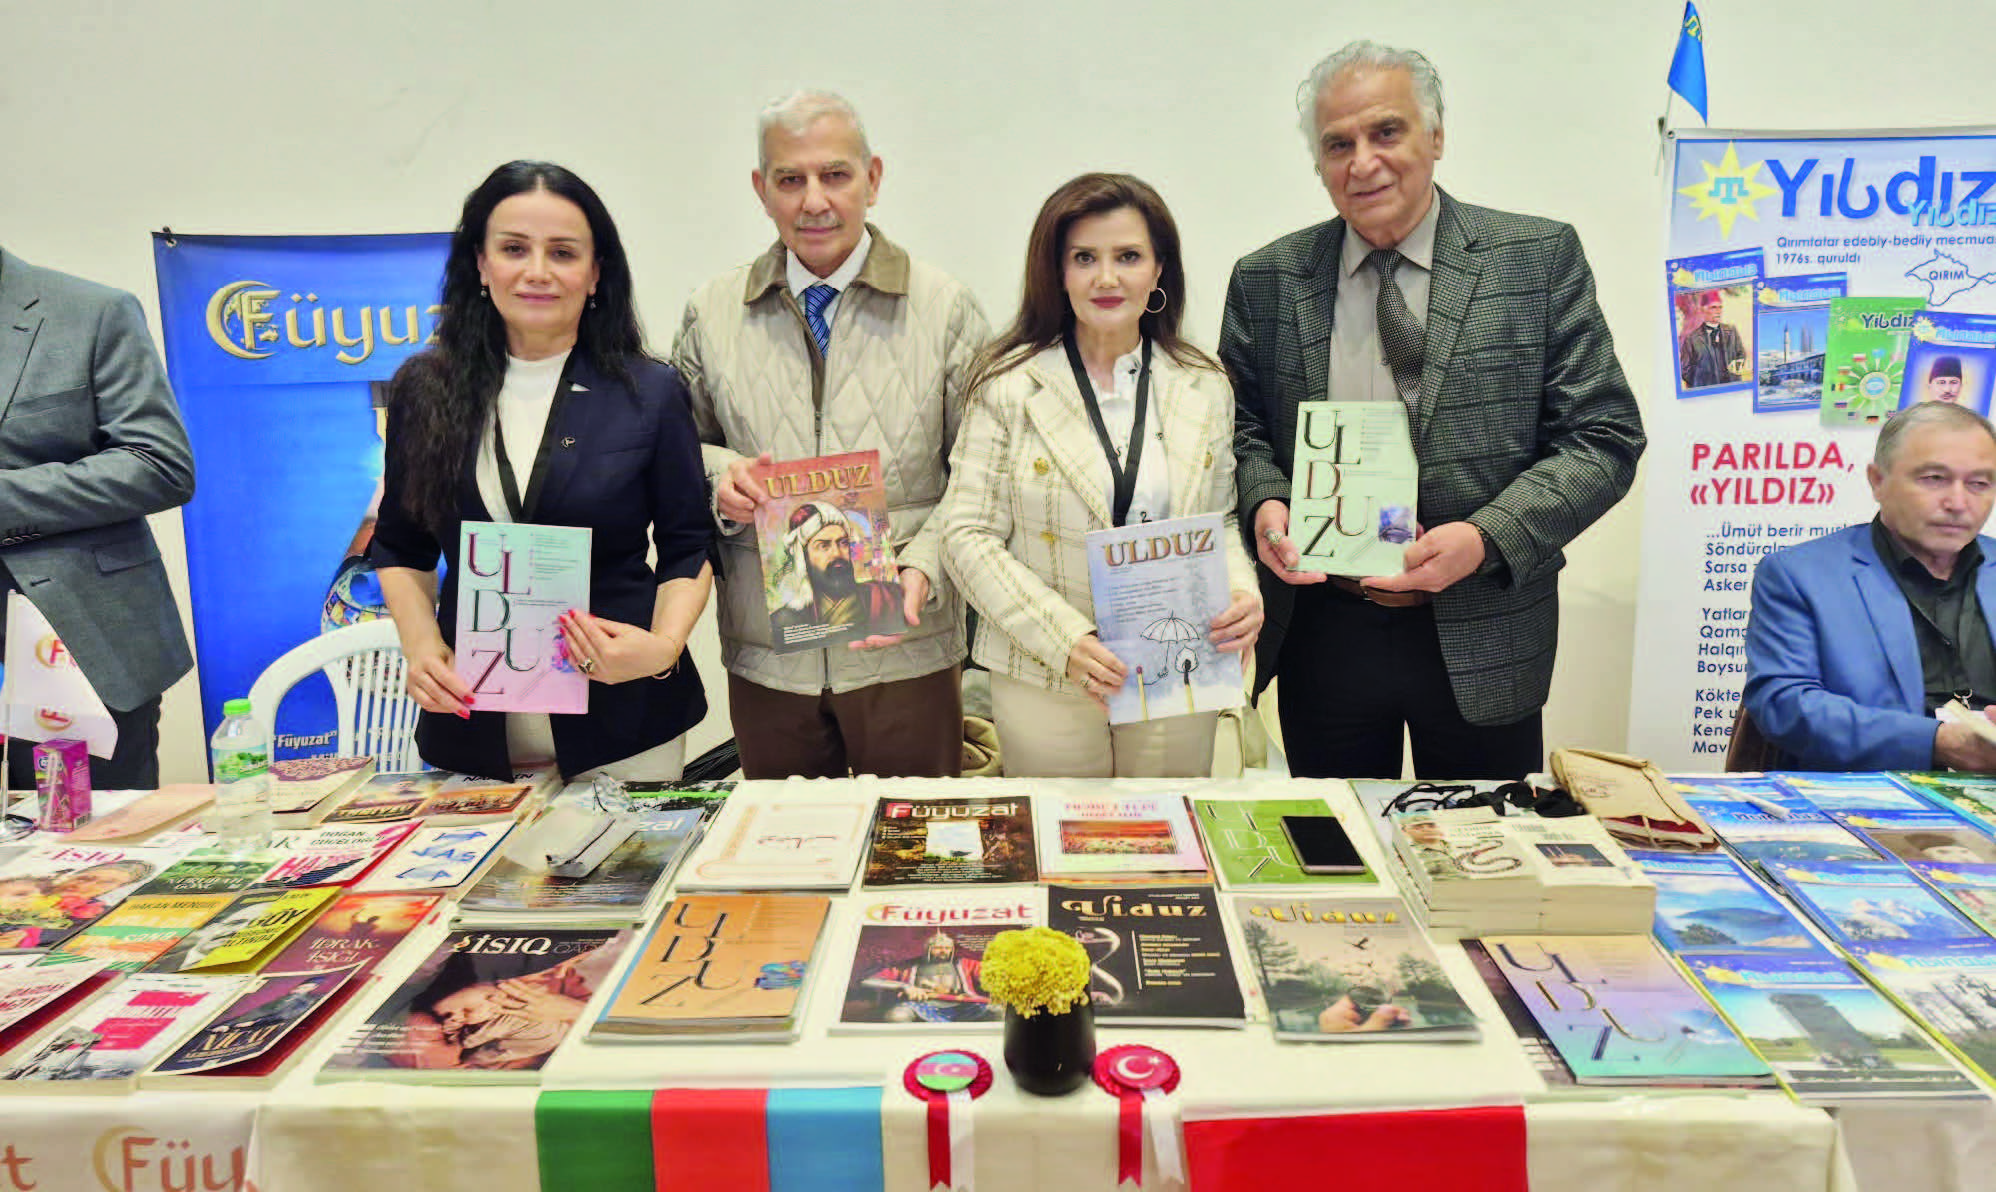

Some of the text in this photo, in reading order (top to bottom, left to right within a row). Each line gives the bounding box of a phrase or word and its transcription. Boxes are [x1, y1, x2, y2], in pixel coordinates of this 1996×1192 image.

[1936, 235, 1996, 245] mecmua
[1929, 270, 1965, 281] QIRIM
[1691, 441, 1854, 472] PARILDA,
[765, 465, 873, 499] ULDUZ
[1767, 523, 1804, 537] berir
[1103, 528, 1216, 567] ULDUZ
[1704, 560, 1747, 574] Sarsa
[1704, 578, 1748, 592] Asker
[1694, 706, 1723, 719] Pek
[886, 802, 1019, 822] Füyuzat
[882, 904, 1034, 925] Füyuzat
